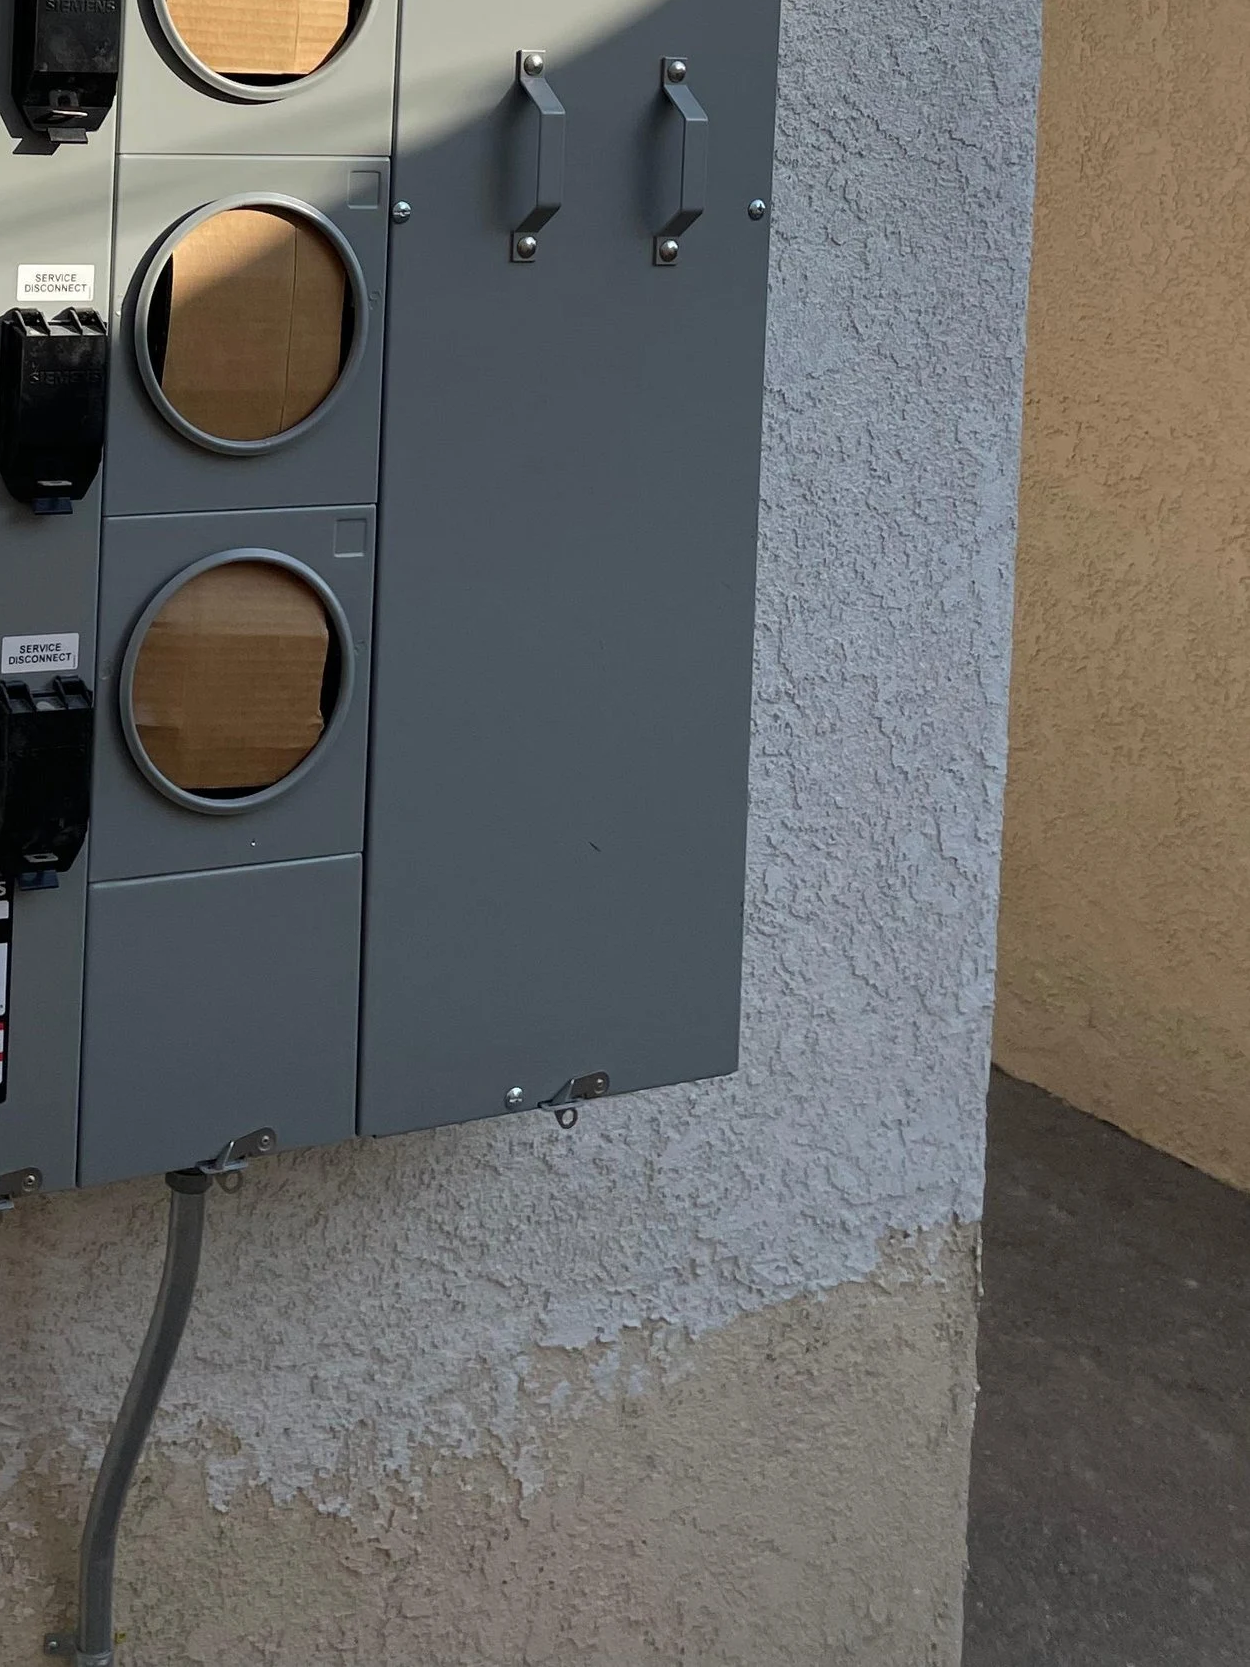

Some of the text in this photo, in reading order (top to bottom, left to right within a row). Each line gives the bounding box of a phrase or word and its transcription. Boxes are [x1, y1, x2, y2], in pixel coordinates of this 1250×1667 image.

[35, 273, 77, 283] SERVICE
[24, 283, 87, 293] DISCONNECT
[19, 642, 62, 654] SERVICE
[8, 652, 72, 665] DISCONNECT
